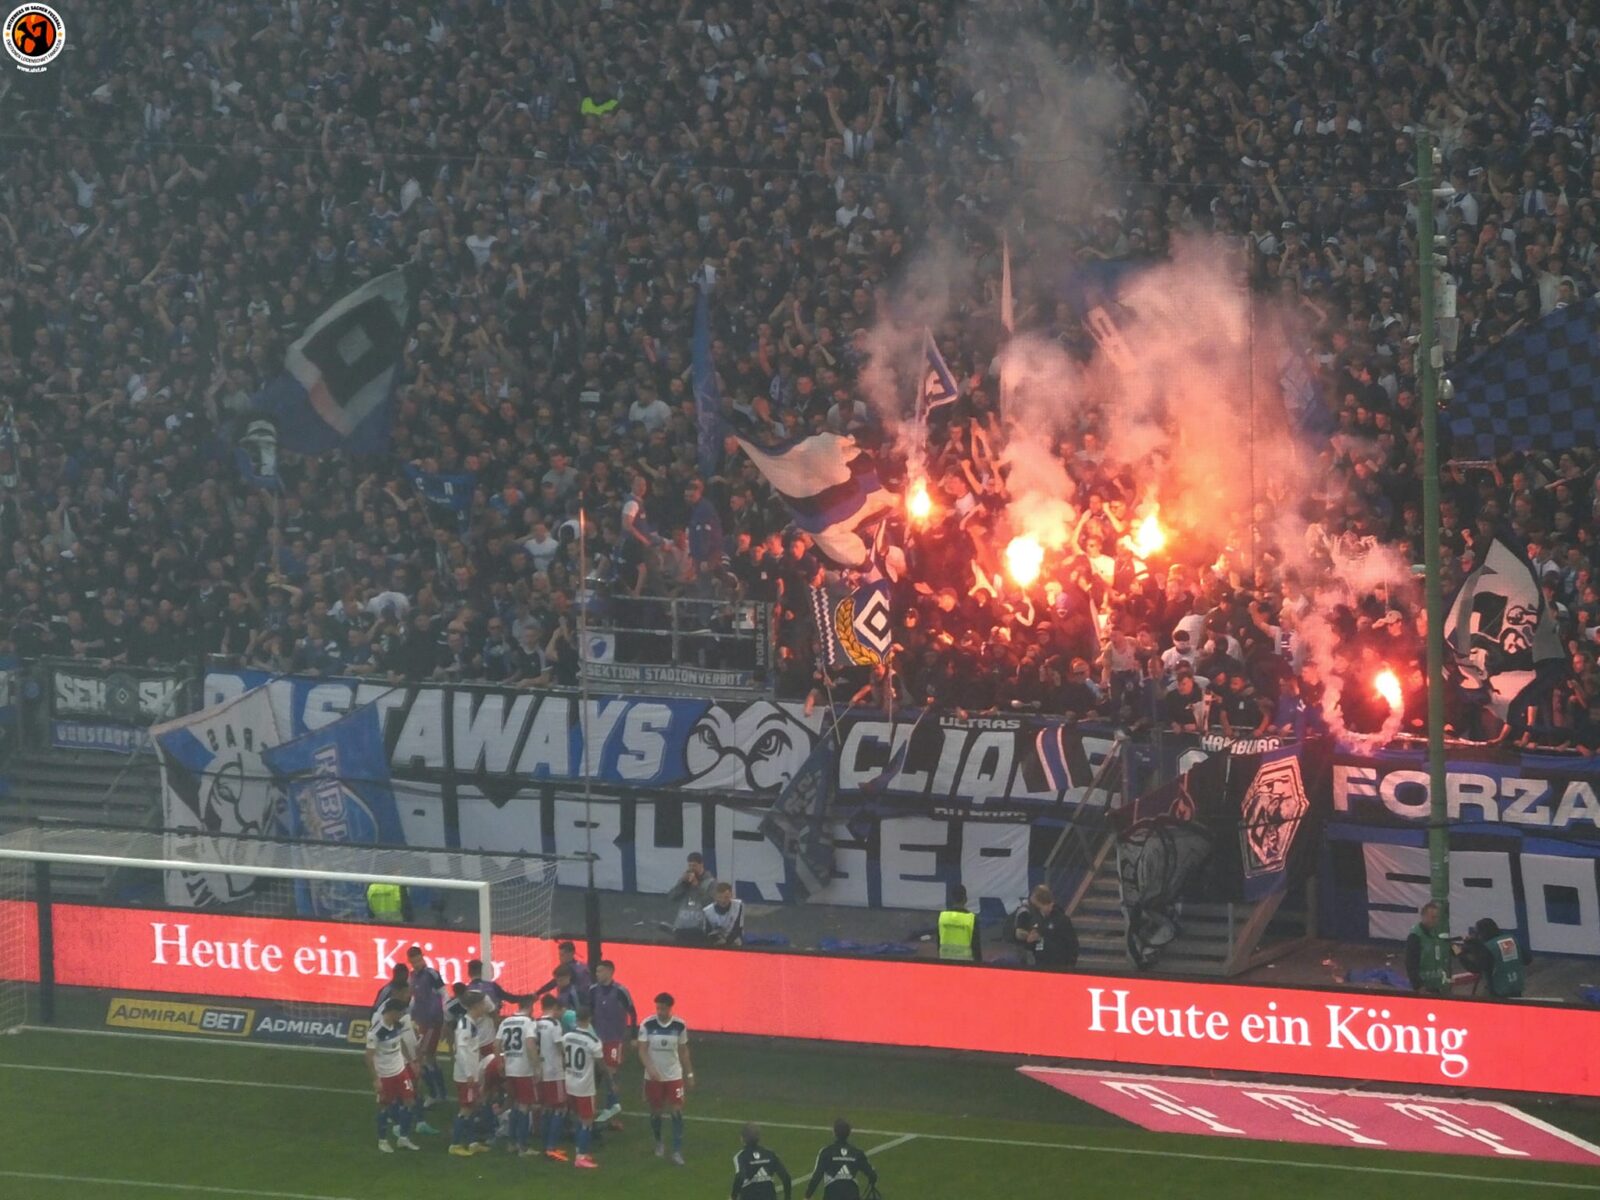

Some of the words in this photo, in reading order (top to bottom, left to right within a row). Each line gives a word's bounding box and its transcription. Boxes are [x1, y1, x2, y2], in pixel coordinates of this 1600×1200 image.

[586, 665, 641, 680] SEKTION
[644, 669, 744, 686] STADIONVERBOT
[939, 716, 1021, 730] ULTRAS
[1332, 764, 1600, 828] FORZA
[150, 922, 284, 974] Heute
[293, 935, 360, 978] ein
[502, 1026, 523, 1052] 23
[1088, 987, 1229, 1041] Heute
[1240, 1001, 1312, 1047] ein
[1325, 1004, 1469, 1078] König
[564, 1044, 586, 1071] 10
